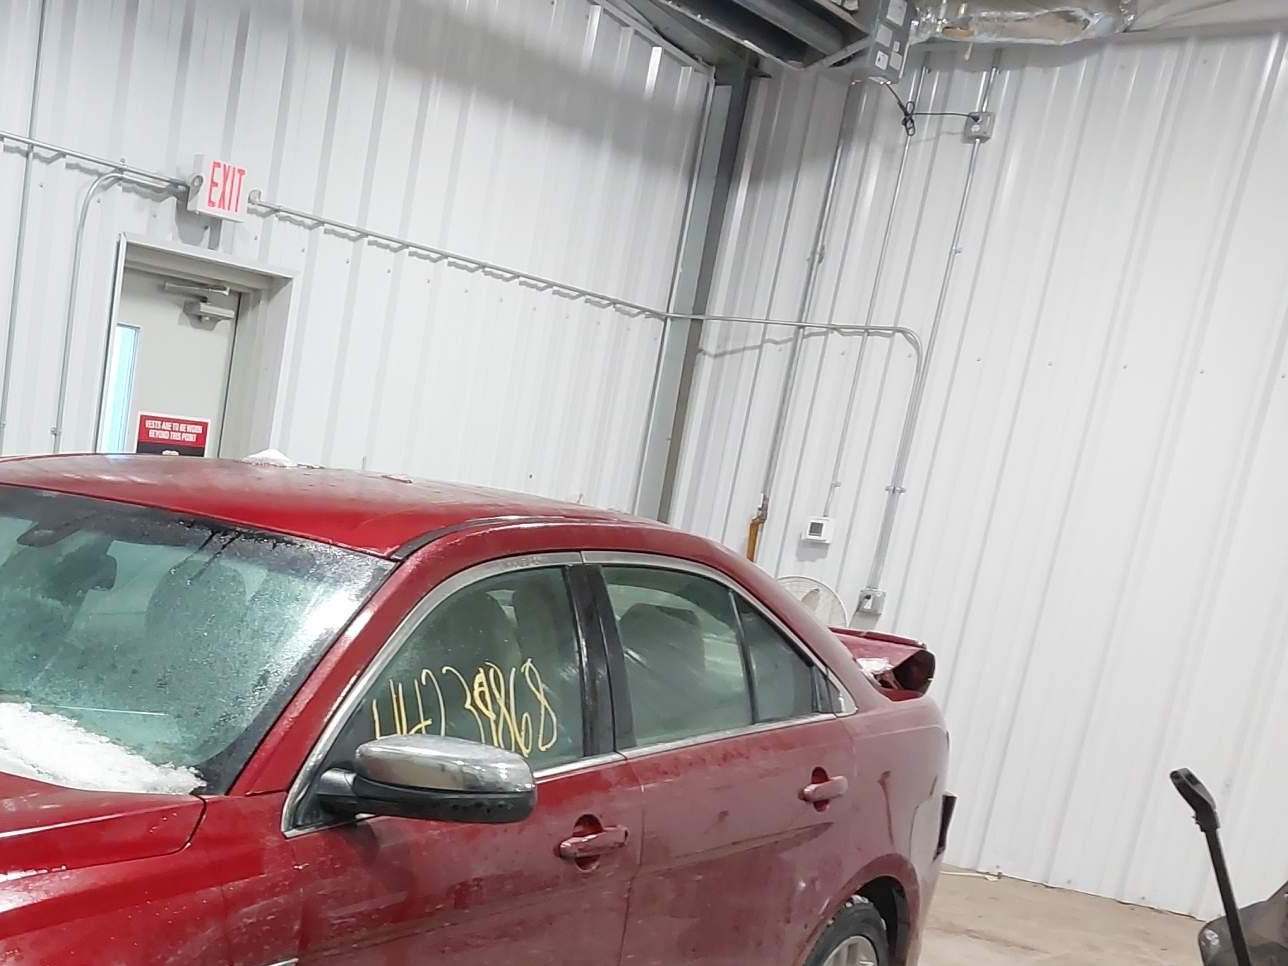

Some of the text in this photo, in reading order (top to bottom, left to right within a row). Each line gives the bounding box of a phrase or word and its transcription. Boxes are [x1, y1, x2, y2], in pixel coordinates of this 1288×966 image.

[207, 160, 246, 213] EXIT
[162, 421, 172, 431] ARE
[172, 422, 180, 432] TO
[180, 423, 187, 432] BE
[148, 429, 197, 442] BEYOND THIS POINT
